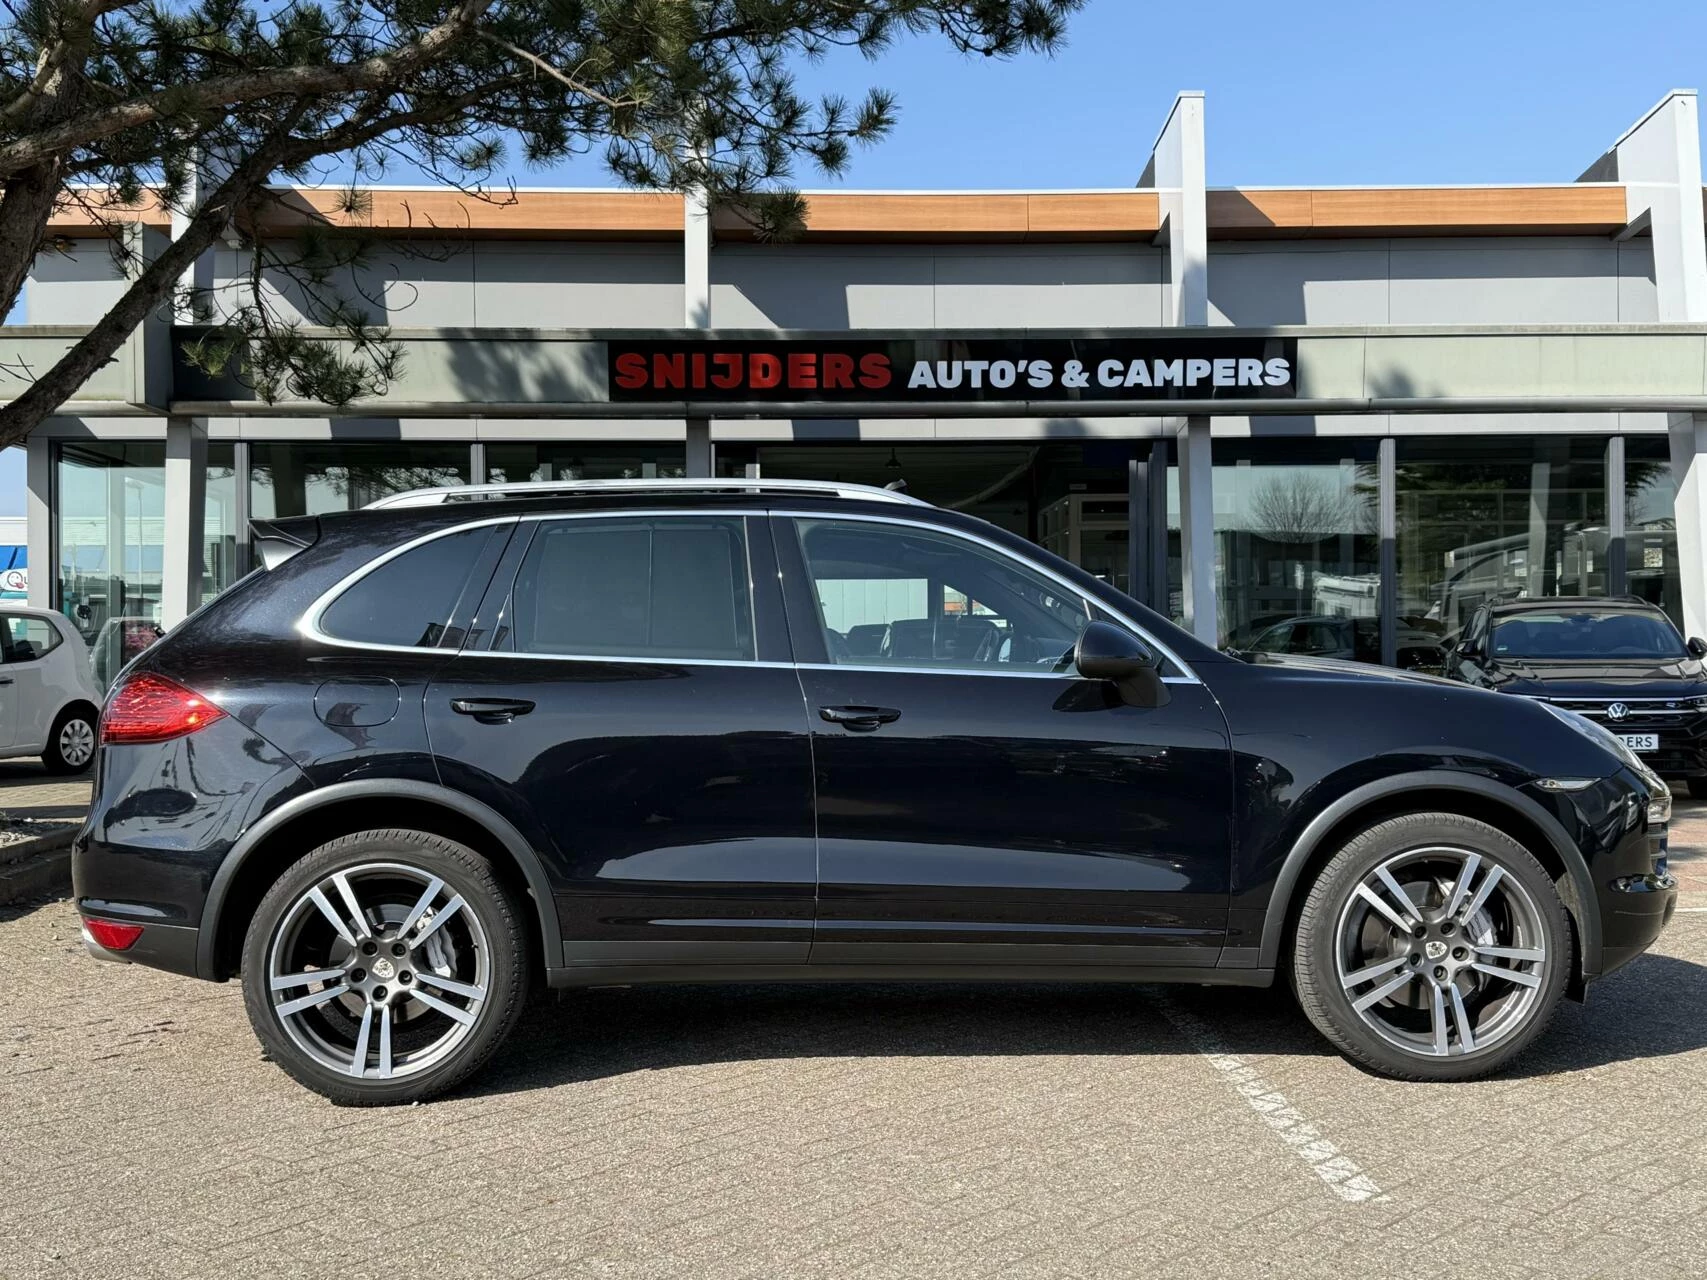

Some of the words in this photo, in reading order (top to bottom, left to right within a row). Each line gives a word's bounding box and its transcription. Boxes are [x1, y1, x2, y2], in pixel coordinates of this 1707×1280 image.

[615, 353, 892, 389] SNIJDERS
[907, 360, 1053, 389] AUTO'S
[1061, 360, 1090, 387] &
[1098, 358, 1291, 387] CAMPERS
[1618, 736, 1653, 748] ERS
